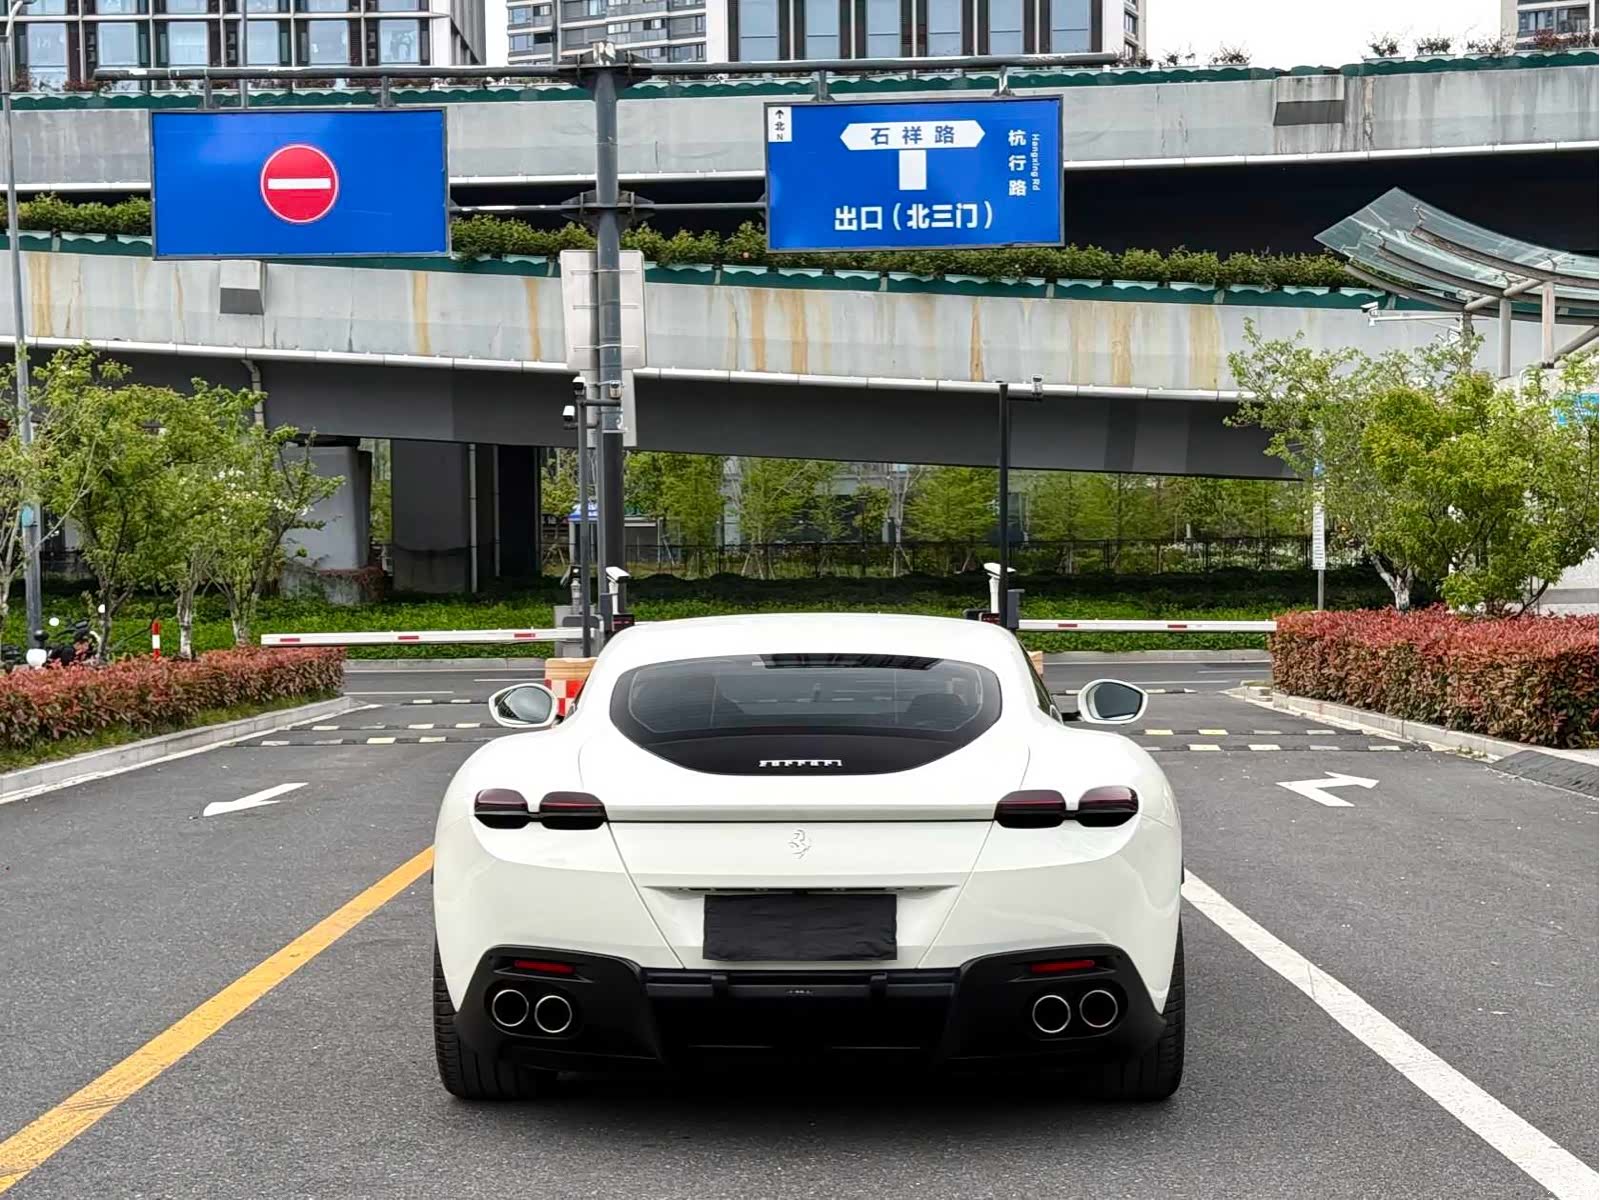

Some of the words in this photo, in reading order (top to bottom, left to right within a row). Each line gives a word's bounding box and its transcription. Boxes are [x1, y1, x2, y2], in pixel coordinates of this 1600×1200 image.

[774, 121, 785, 131] 北
[776, 133, 784, 141] N
[870, 125, 955, 145] 石祥路
[1008, 129, 1027, 196] 杭行路
[1030, 133, 1041, 177] Hangxing
[1032, 178, 1041, 191] Rd
